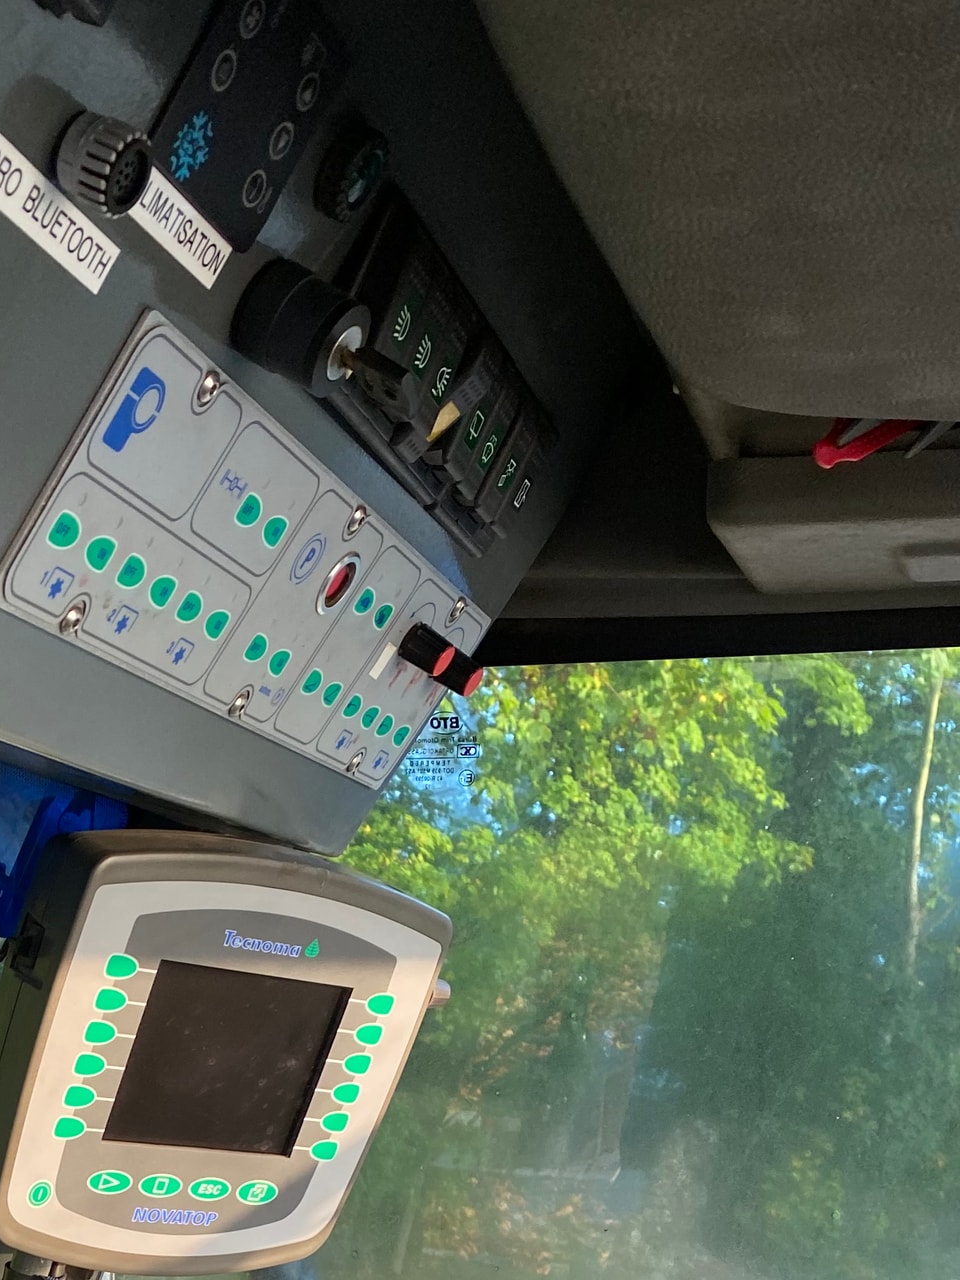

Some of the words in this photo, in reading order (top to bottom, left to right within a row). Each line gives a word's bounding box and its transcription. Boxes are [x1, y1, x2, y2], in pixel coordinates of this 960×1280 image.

[22, 185, 112, 279] BLUETOOTH
[139, 180, 227, 275] LIMATISATION
[55, 521, 71, 537] OFF
[97, 547, 107, 560] ON
[122, 564, 138, 578] OFF
[224, 929, 302, 958] Tecnoma
[198, 1182, 221, 1195] ESC
[132, 1207, 218, 1226] NOVATOP
